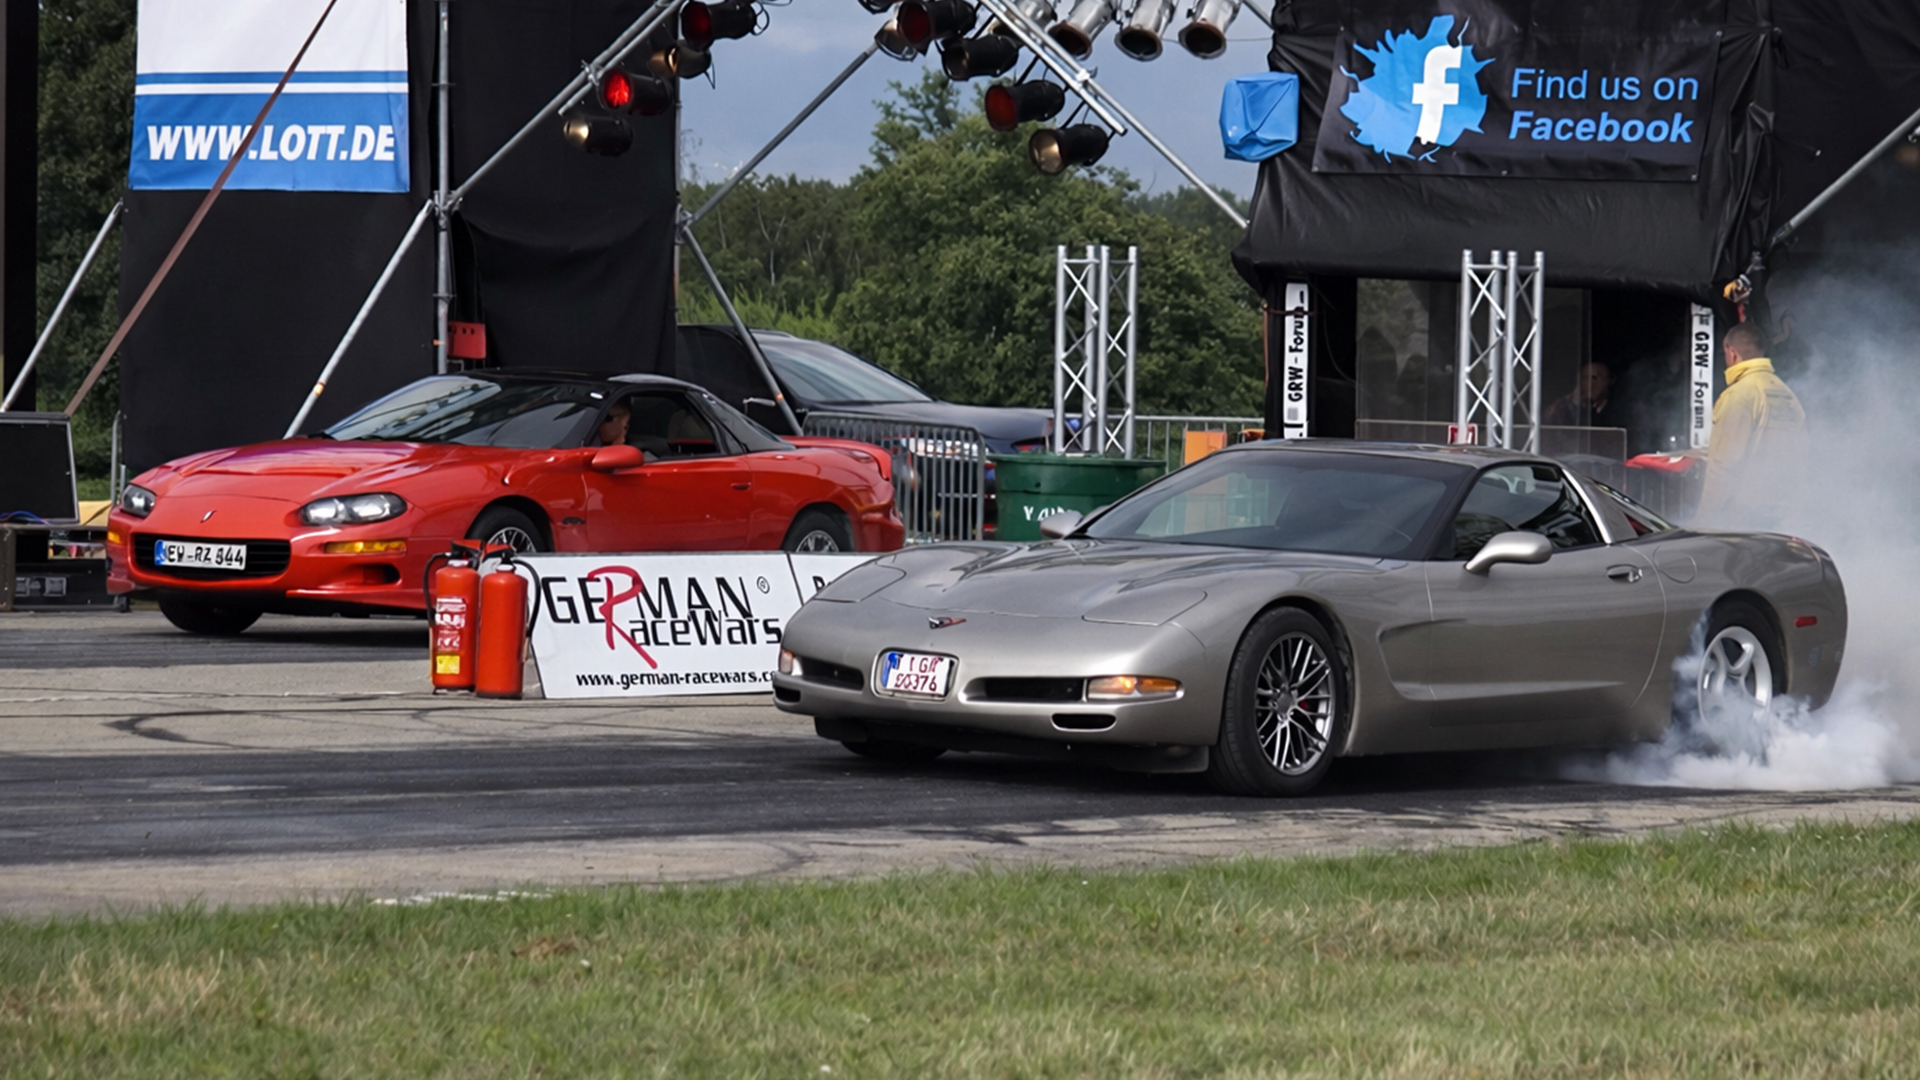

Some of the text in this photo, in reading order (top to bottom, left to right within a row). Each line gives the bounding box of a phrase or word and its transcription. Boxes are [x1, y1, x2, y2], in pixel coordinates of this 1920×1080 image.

[1511, 67, 1699, 101] Find us on
[147, 124, 395, 162] WWW.LOTT.DE
[1508, 110, 1695, 143] Facebook
[1694, 331, 1710, 368] GRW
[1288, 366, 1304, 403] GRW
[541, 566, 754, 624] GERMAN
